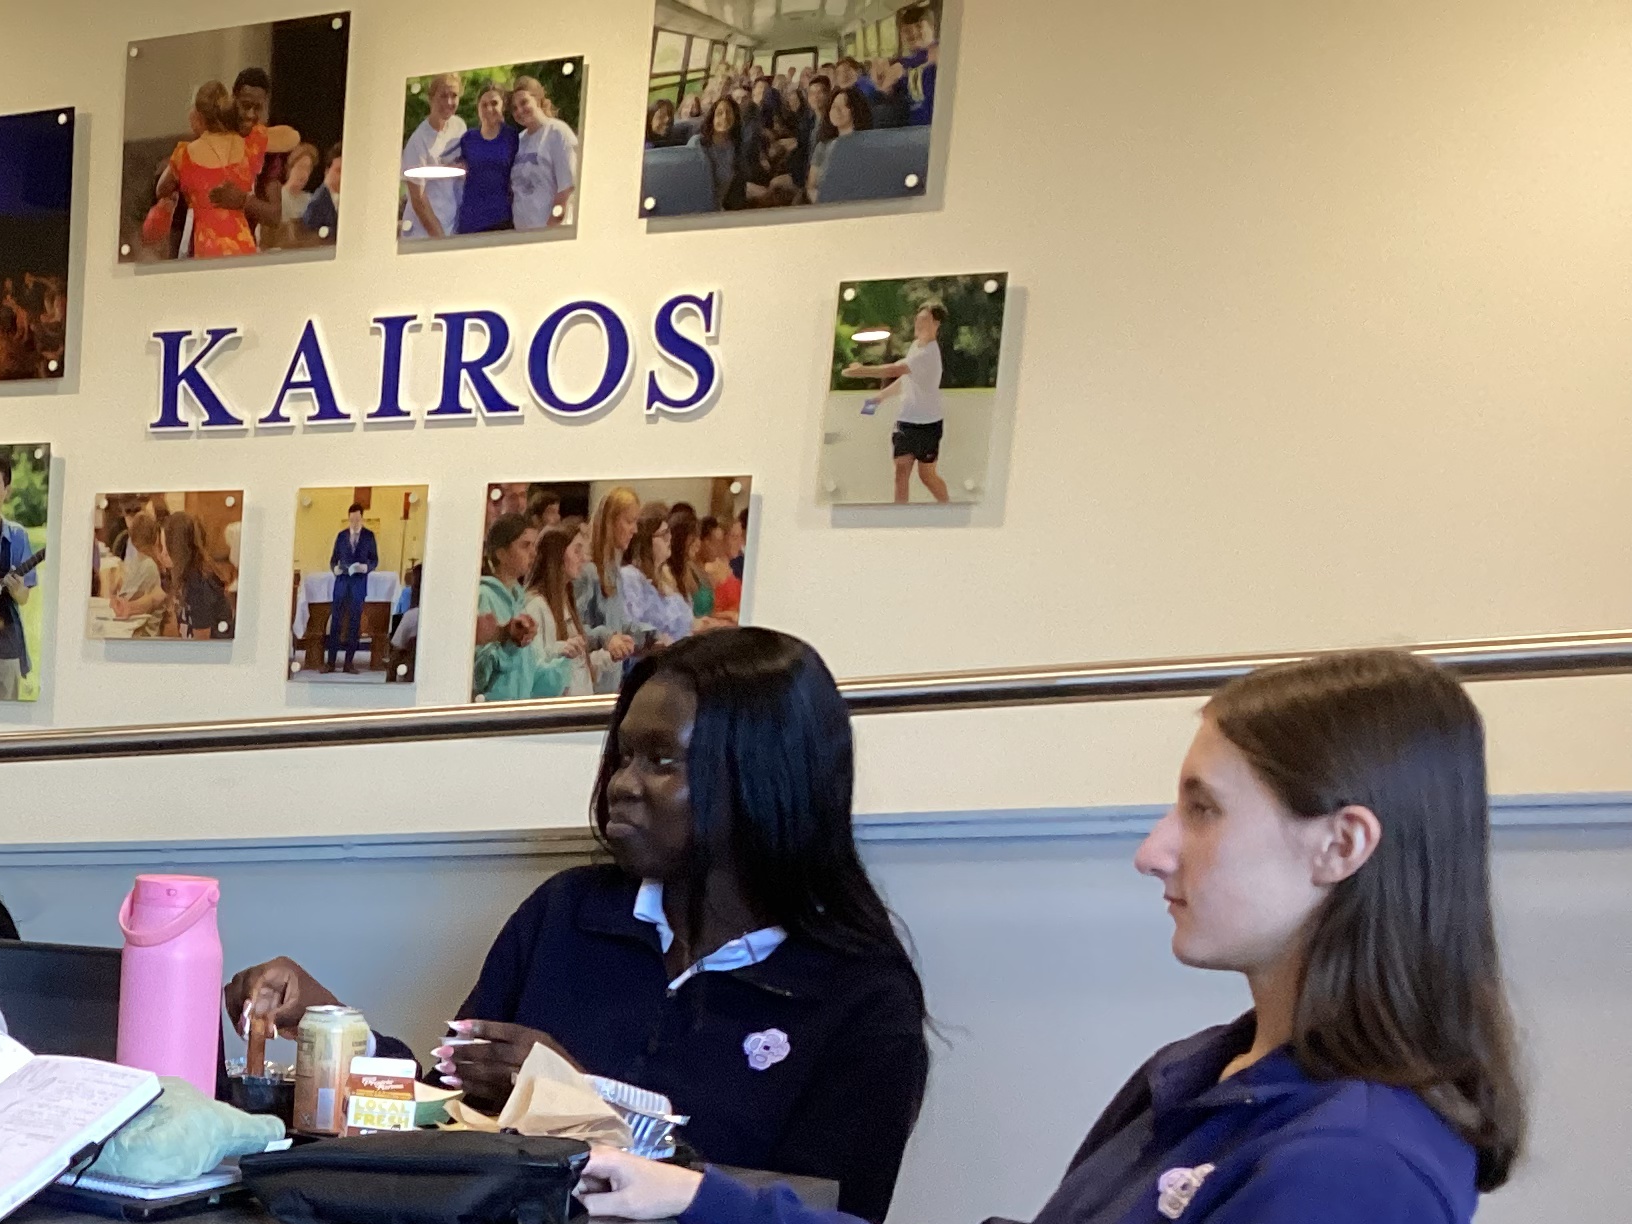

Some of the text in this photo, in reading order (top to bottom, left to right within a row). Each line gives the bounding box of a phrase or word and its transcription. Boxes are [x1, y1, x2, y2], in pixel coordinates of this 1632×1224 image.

[148, 290, 720, 431] KAIROS
[355, 1098, 411, 1114] LOCAL
[353, 1112, 410, 1129] FRESH
